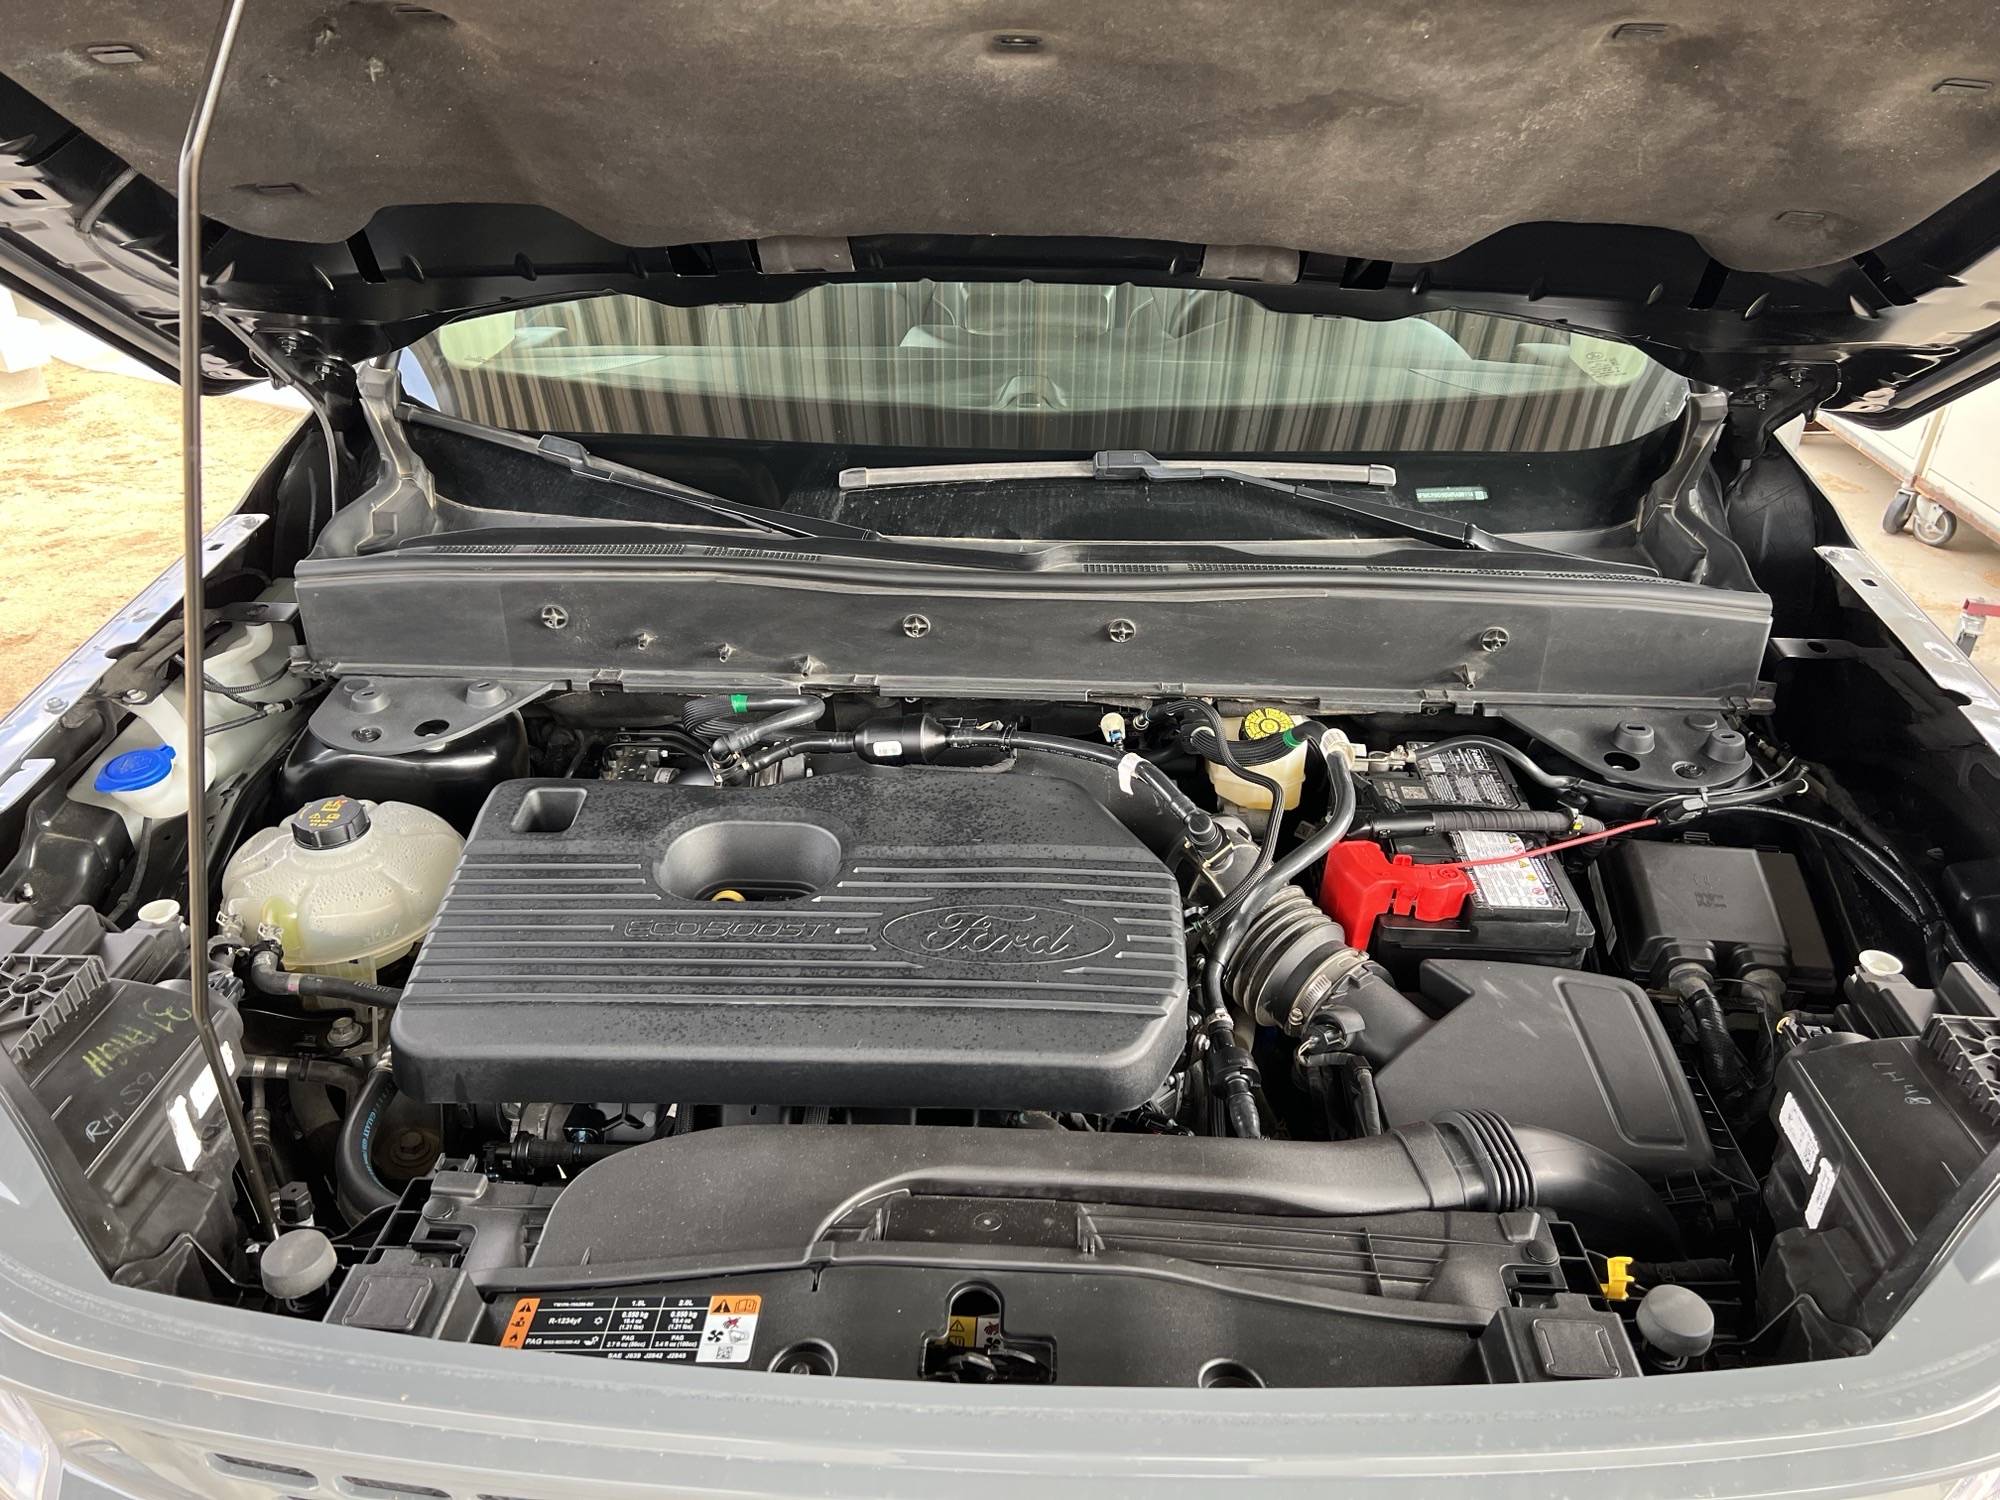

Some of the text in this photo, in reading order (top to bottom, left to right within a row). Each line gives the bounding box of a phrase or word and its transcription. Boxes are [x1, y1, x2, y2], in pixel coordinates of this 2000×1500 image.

[624, 918, 830, 938] ECOBOOST
[919, 911, 1075, 955] Ford
[548, 1317, 583, 1326] R-1234yf
